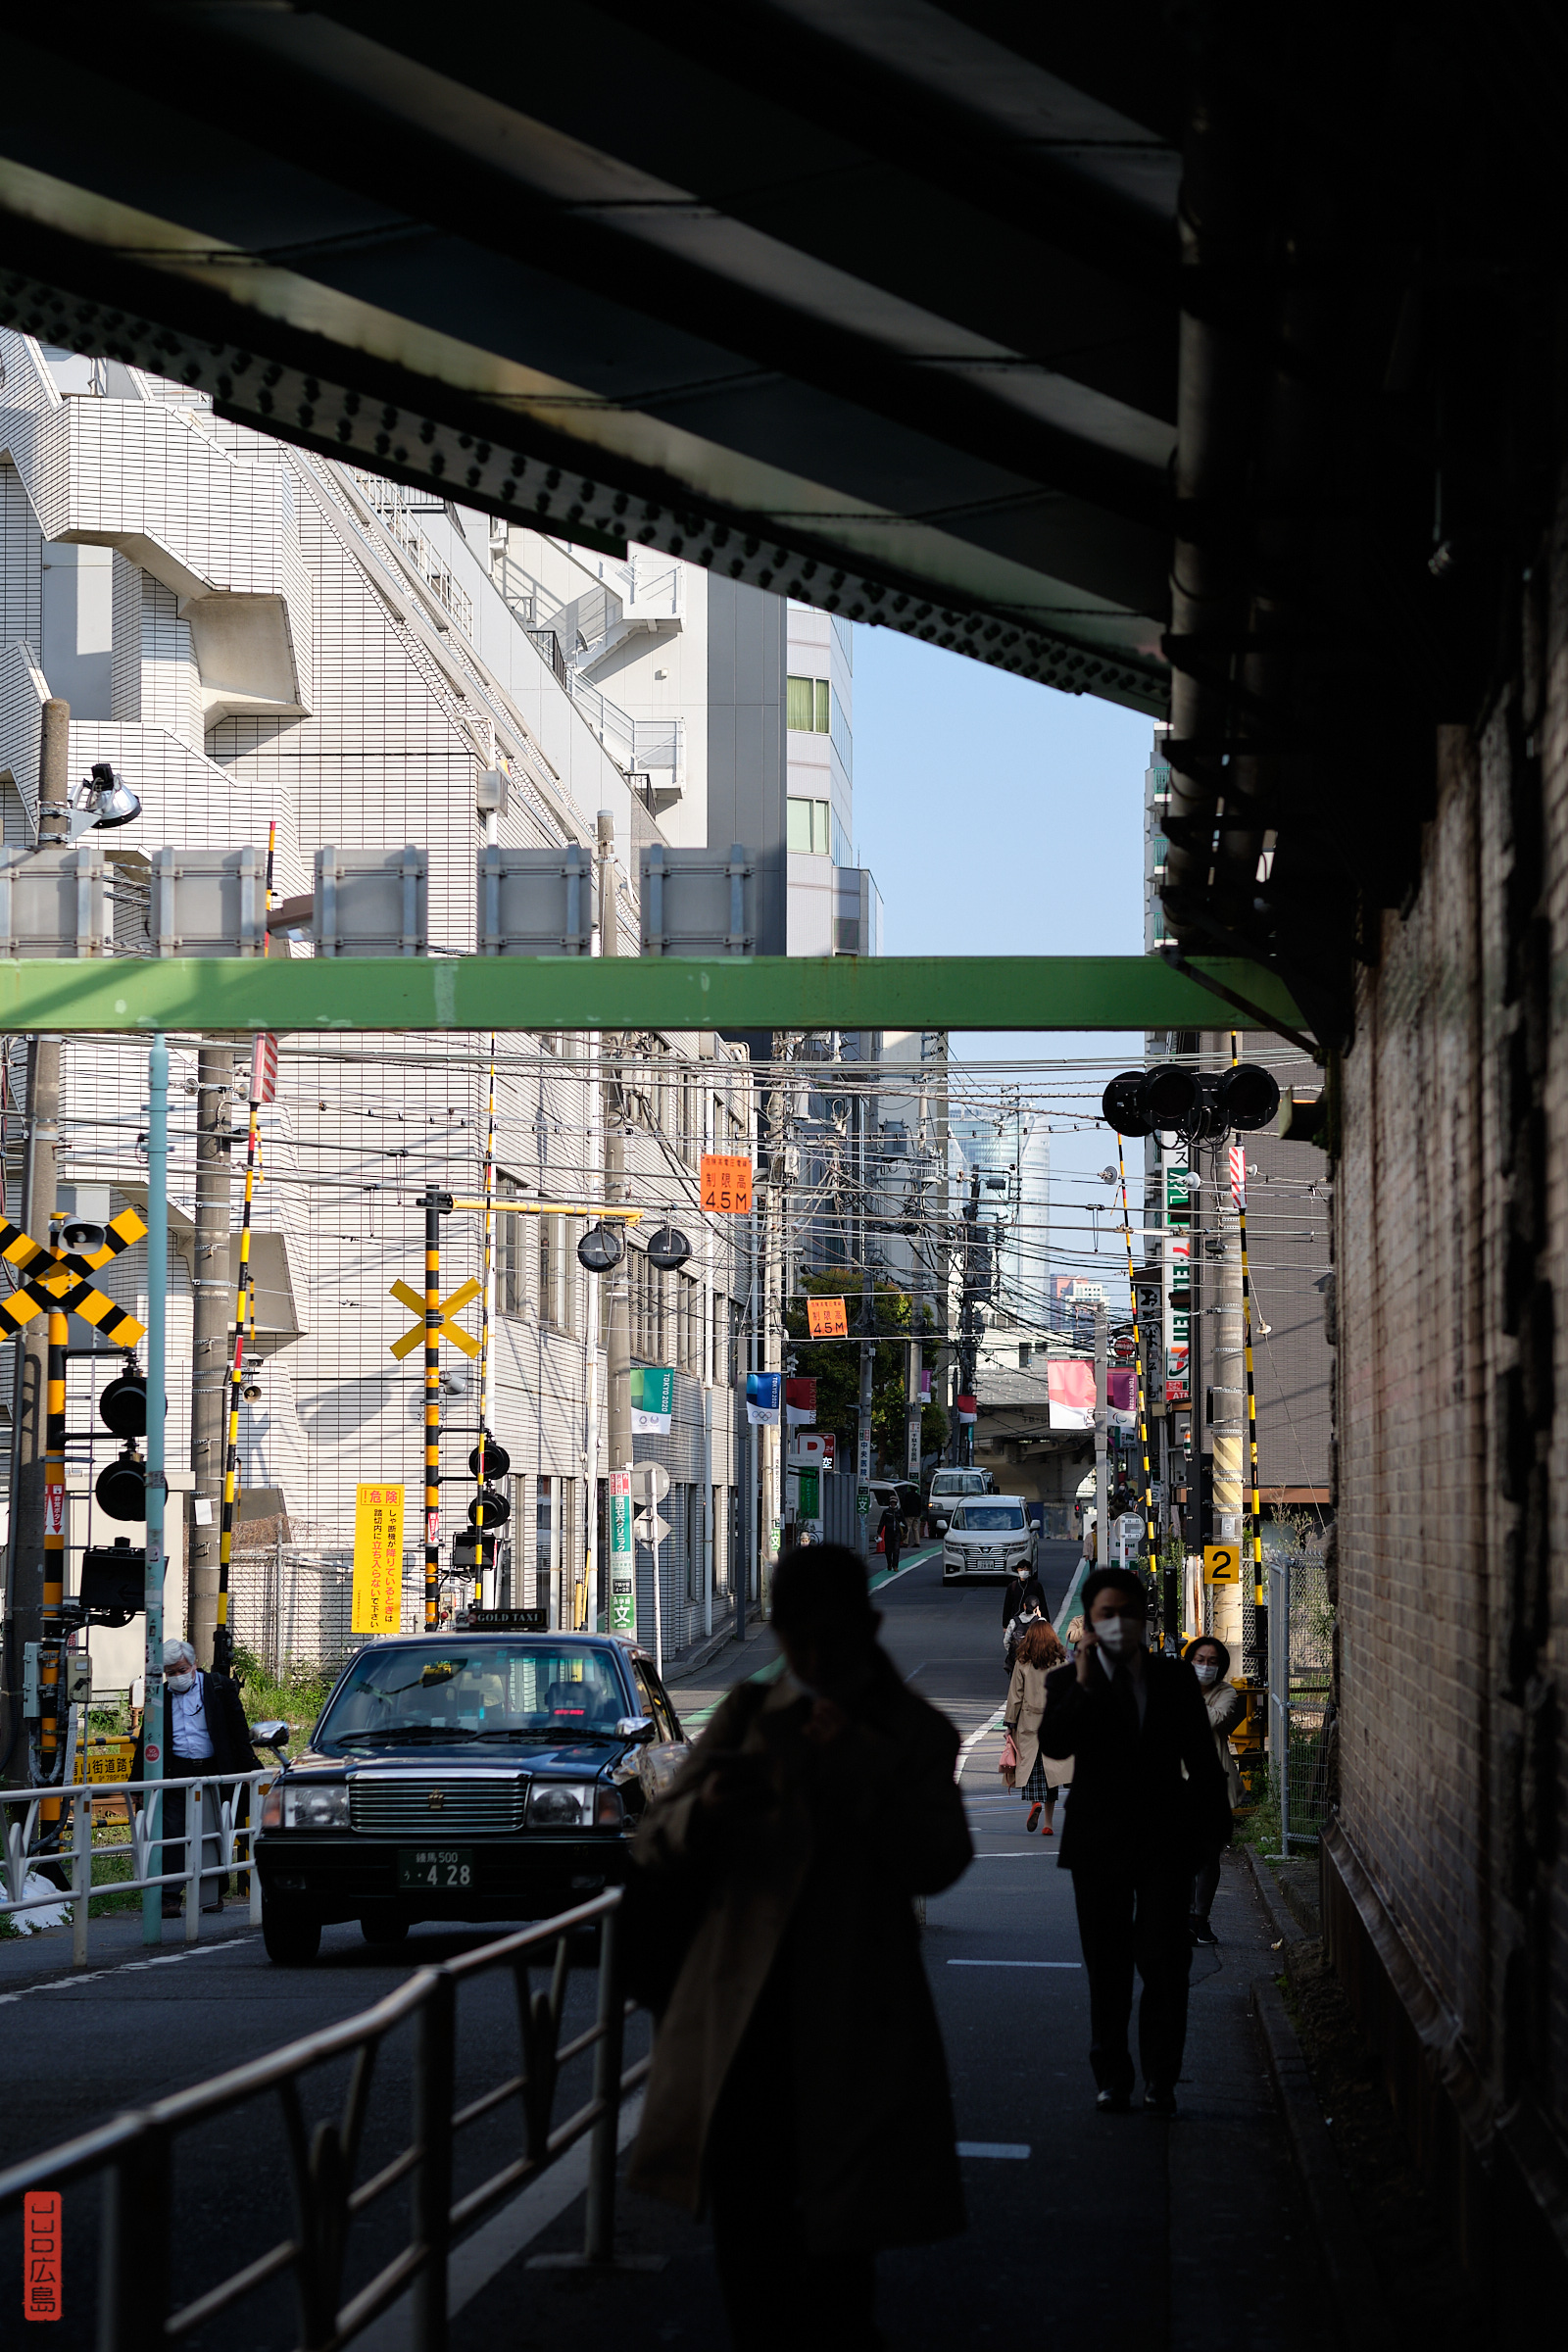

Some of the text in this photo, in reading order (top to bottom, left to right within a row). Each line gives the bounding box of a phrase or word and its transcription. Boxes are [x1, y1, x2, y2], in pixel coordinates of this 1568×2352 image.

[706, 1191, 747, 1210] 4.5M
[661, 1396, 669, 1412] 2020
[370, 1509, 382, 1628] 踏切内に立ち入らないで下さい
[385, 1509, 397, 1622] しゃ断機が降りているときは
[1212, 1551, 1231, 1578] 2
[477, 1613, 538, 1622] GOLD TAXI
[416, 1852, 458, 1863] 練馬 500
[447, 1865, 470, 1886] 28
